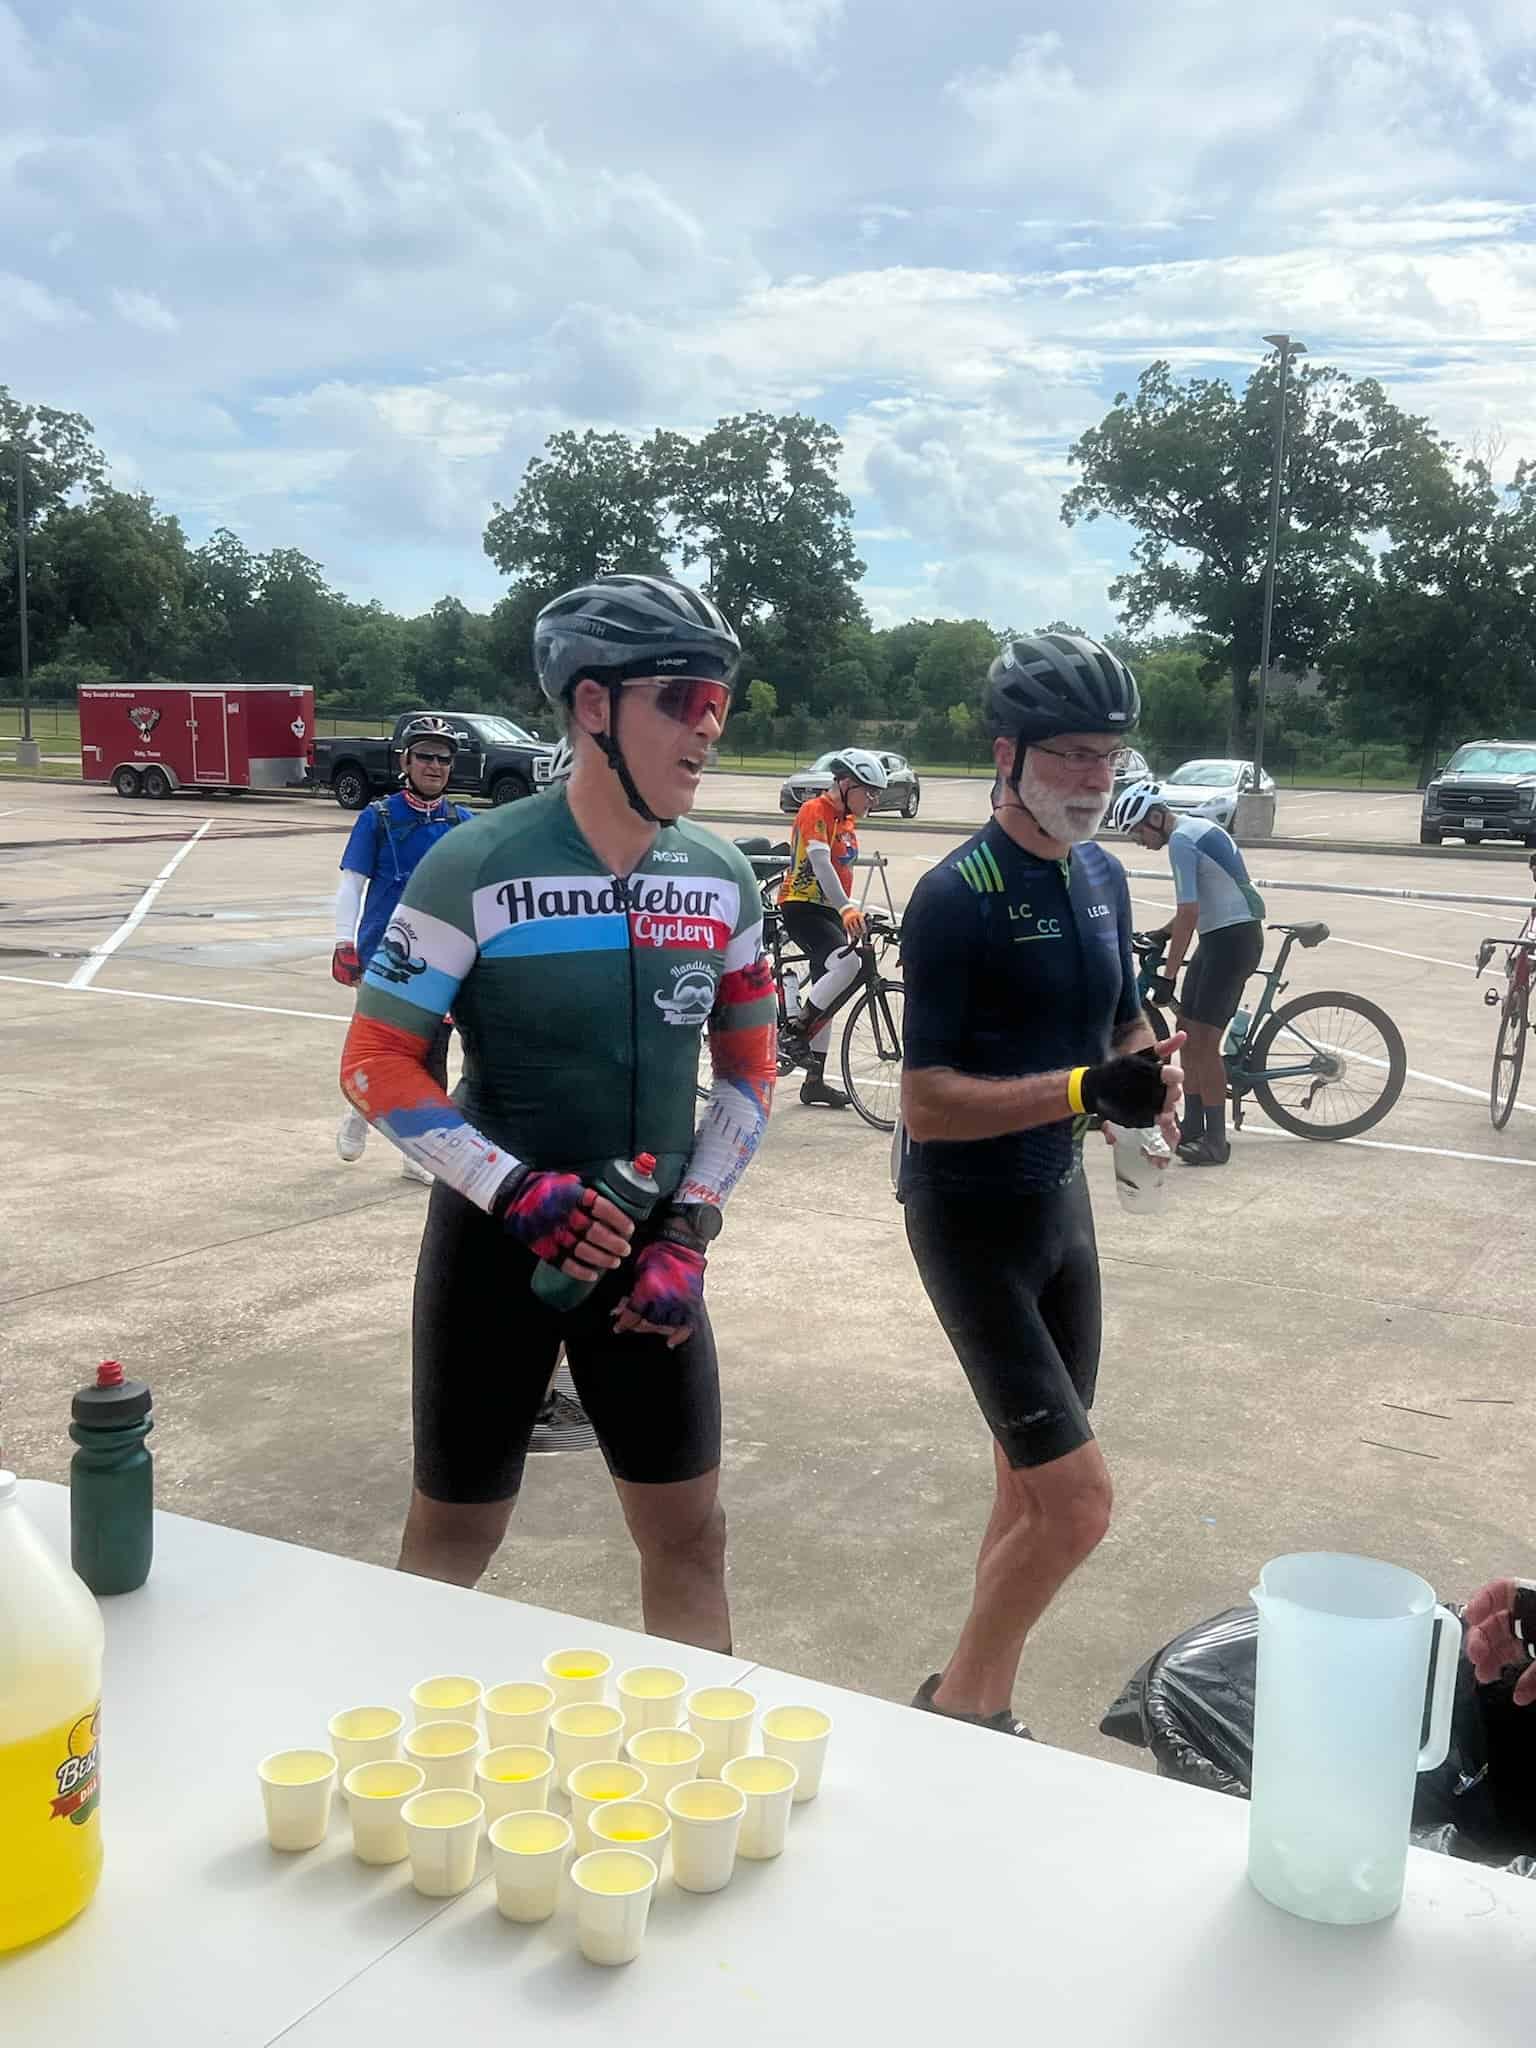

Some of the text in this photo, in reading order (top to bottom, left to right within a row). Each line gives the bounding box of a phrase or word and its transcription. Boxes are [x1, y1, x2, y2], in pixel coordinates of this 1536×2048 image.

[497, 879, 719, 924] Handlebar
[1008, 904, 1032, 919] LC
[635, 916, 715, 949] Cyclery
[1037, 919, 1060, 933] CC
